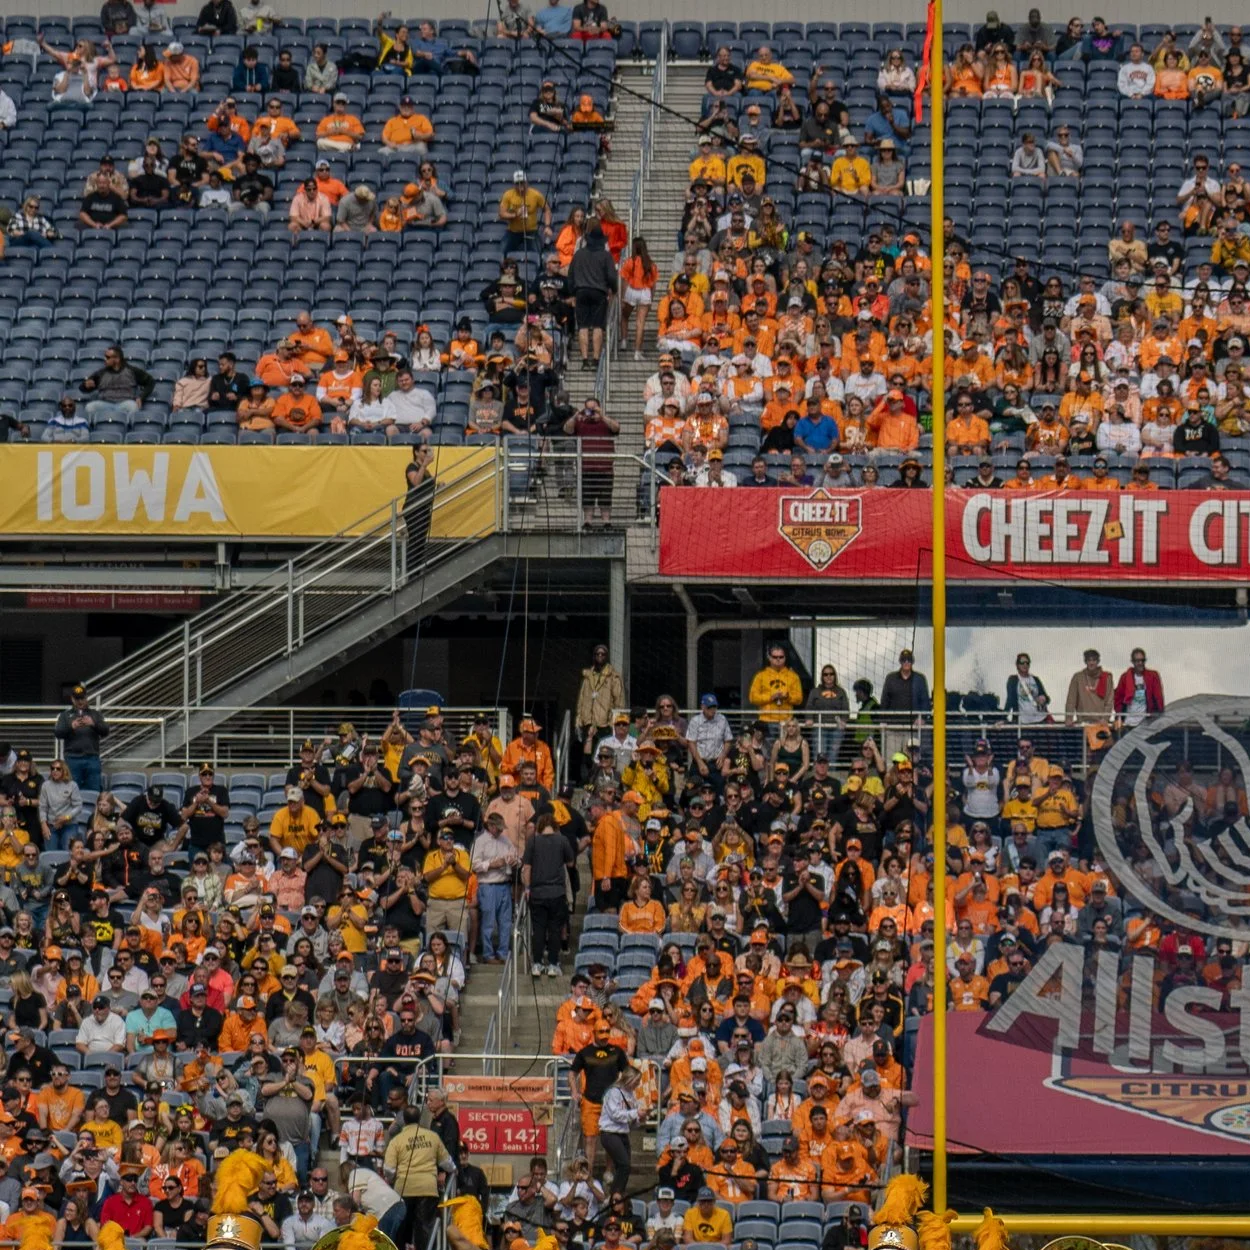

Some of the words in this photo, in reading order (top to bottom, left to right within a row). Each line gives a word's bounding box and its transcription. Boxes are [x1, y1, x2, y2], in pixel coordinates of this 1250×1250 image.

[37, 450, 227, 522] IOWA
[792, 527, 821, 537] CITRUS
[395, 1044, 421, 1056] VOLS
[468, 1112, 524, 1122] SECTIONS
[407, 1134, 426, 1144] GUEST
[504, 1128, 540, 1143] 147
[503, 1143, 522, 1151] Seats
